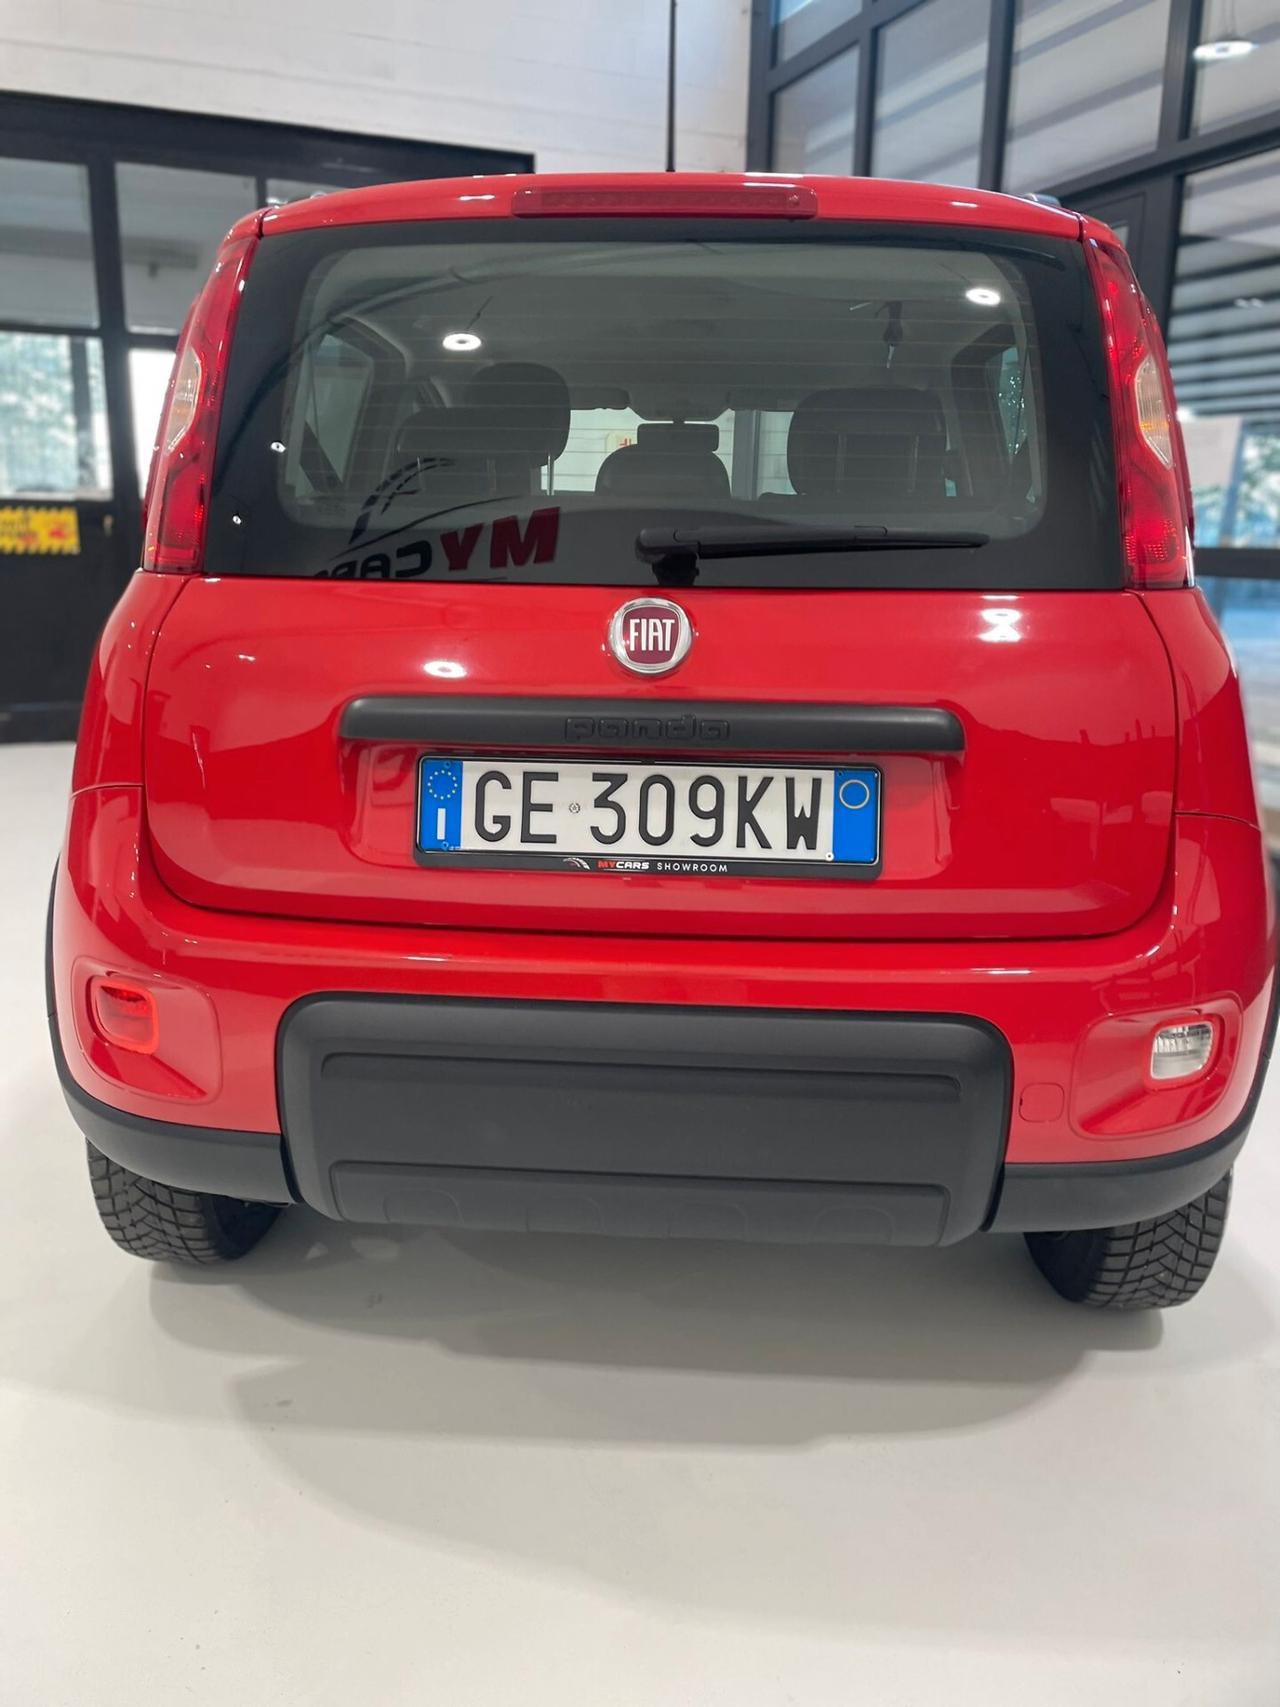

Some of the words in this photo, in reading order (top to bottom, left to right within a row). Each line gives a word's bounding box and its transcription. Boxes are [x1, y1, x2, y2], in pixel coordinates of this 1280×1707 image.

[629, 618, 675, 651] FIAT
[565, 713, 730, 743] panda
[475, 770, 559, 844] GE
[590, 773, 822, 850] 309KW
[598, 860, 650, 870] MYCARS
[657, 862, 728, 872] SHOWROOM
